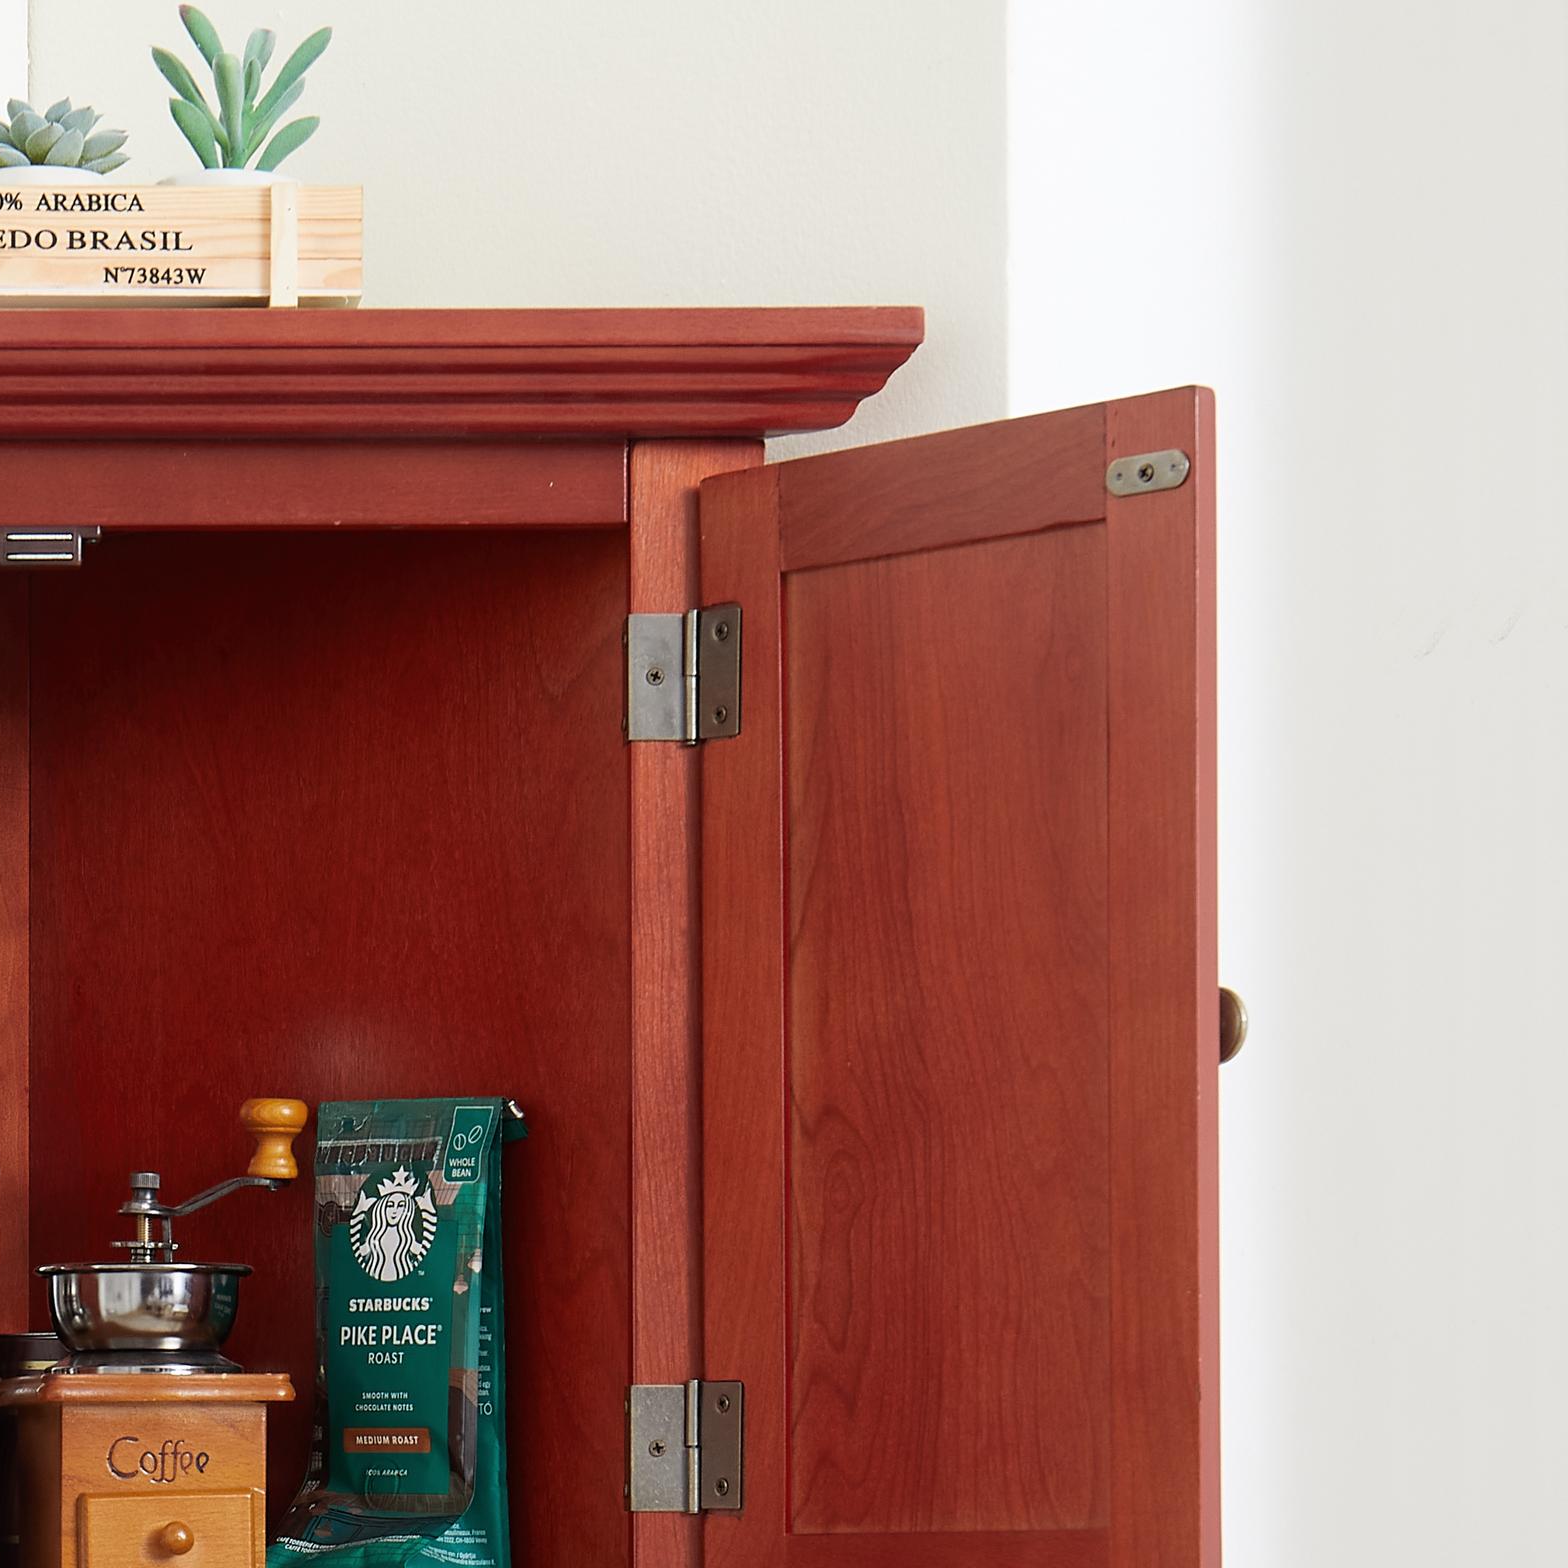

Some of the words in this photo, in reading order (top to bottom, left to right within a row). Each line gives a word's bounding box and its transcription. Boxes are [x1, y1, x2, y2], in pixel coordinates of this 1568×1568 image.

[35, 193, 145, 212] ARABICA
[66, 229, 193, 251] BRASIL
[448, 1157, 476, 1168] WHOLE
[451, 1168, 472, 1178] BEAN
[340, 1325, 377, 1346] PIKE
[367, 1351, 404, 1365] ROAST
[362, 1391, 389, 1400] SMOOTH
[390, 1391, 408, 1399] WITH
[355, 1403, 391, 1412] CHOCOLATE
[392, 1403, 414, 1412] NOTES
[356, 1436, 390, 1445] MEDIUM
[392, 1435, 420, 1445] ROAST
[106, 1436, 210, 1483] Coffee
